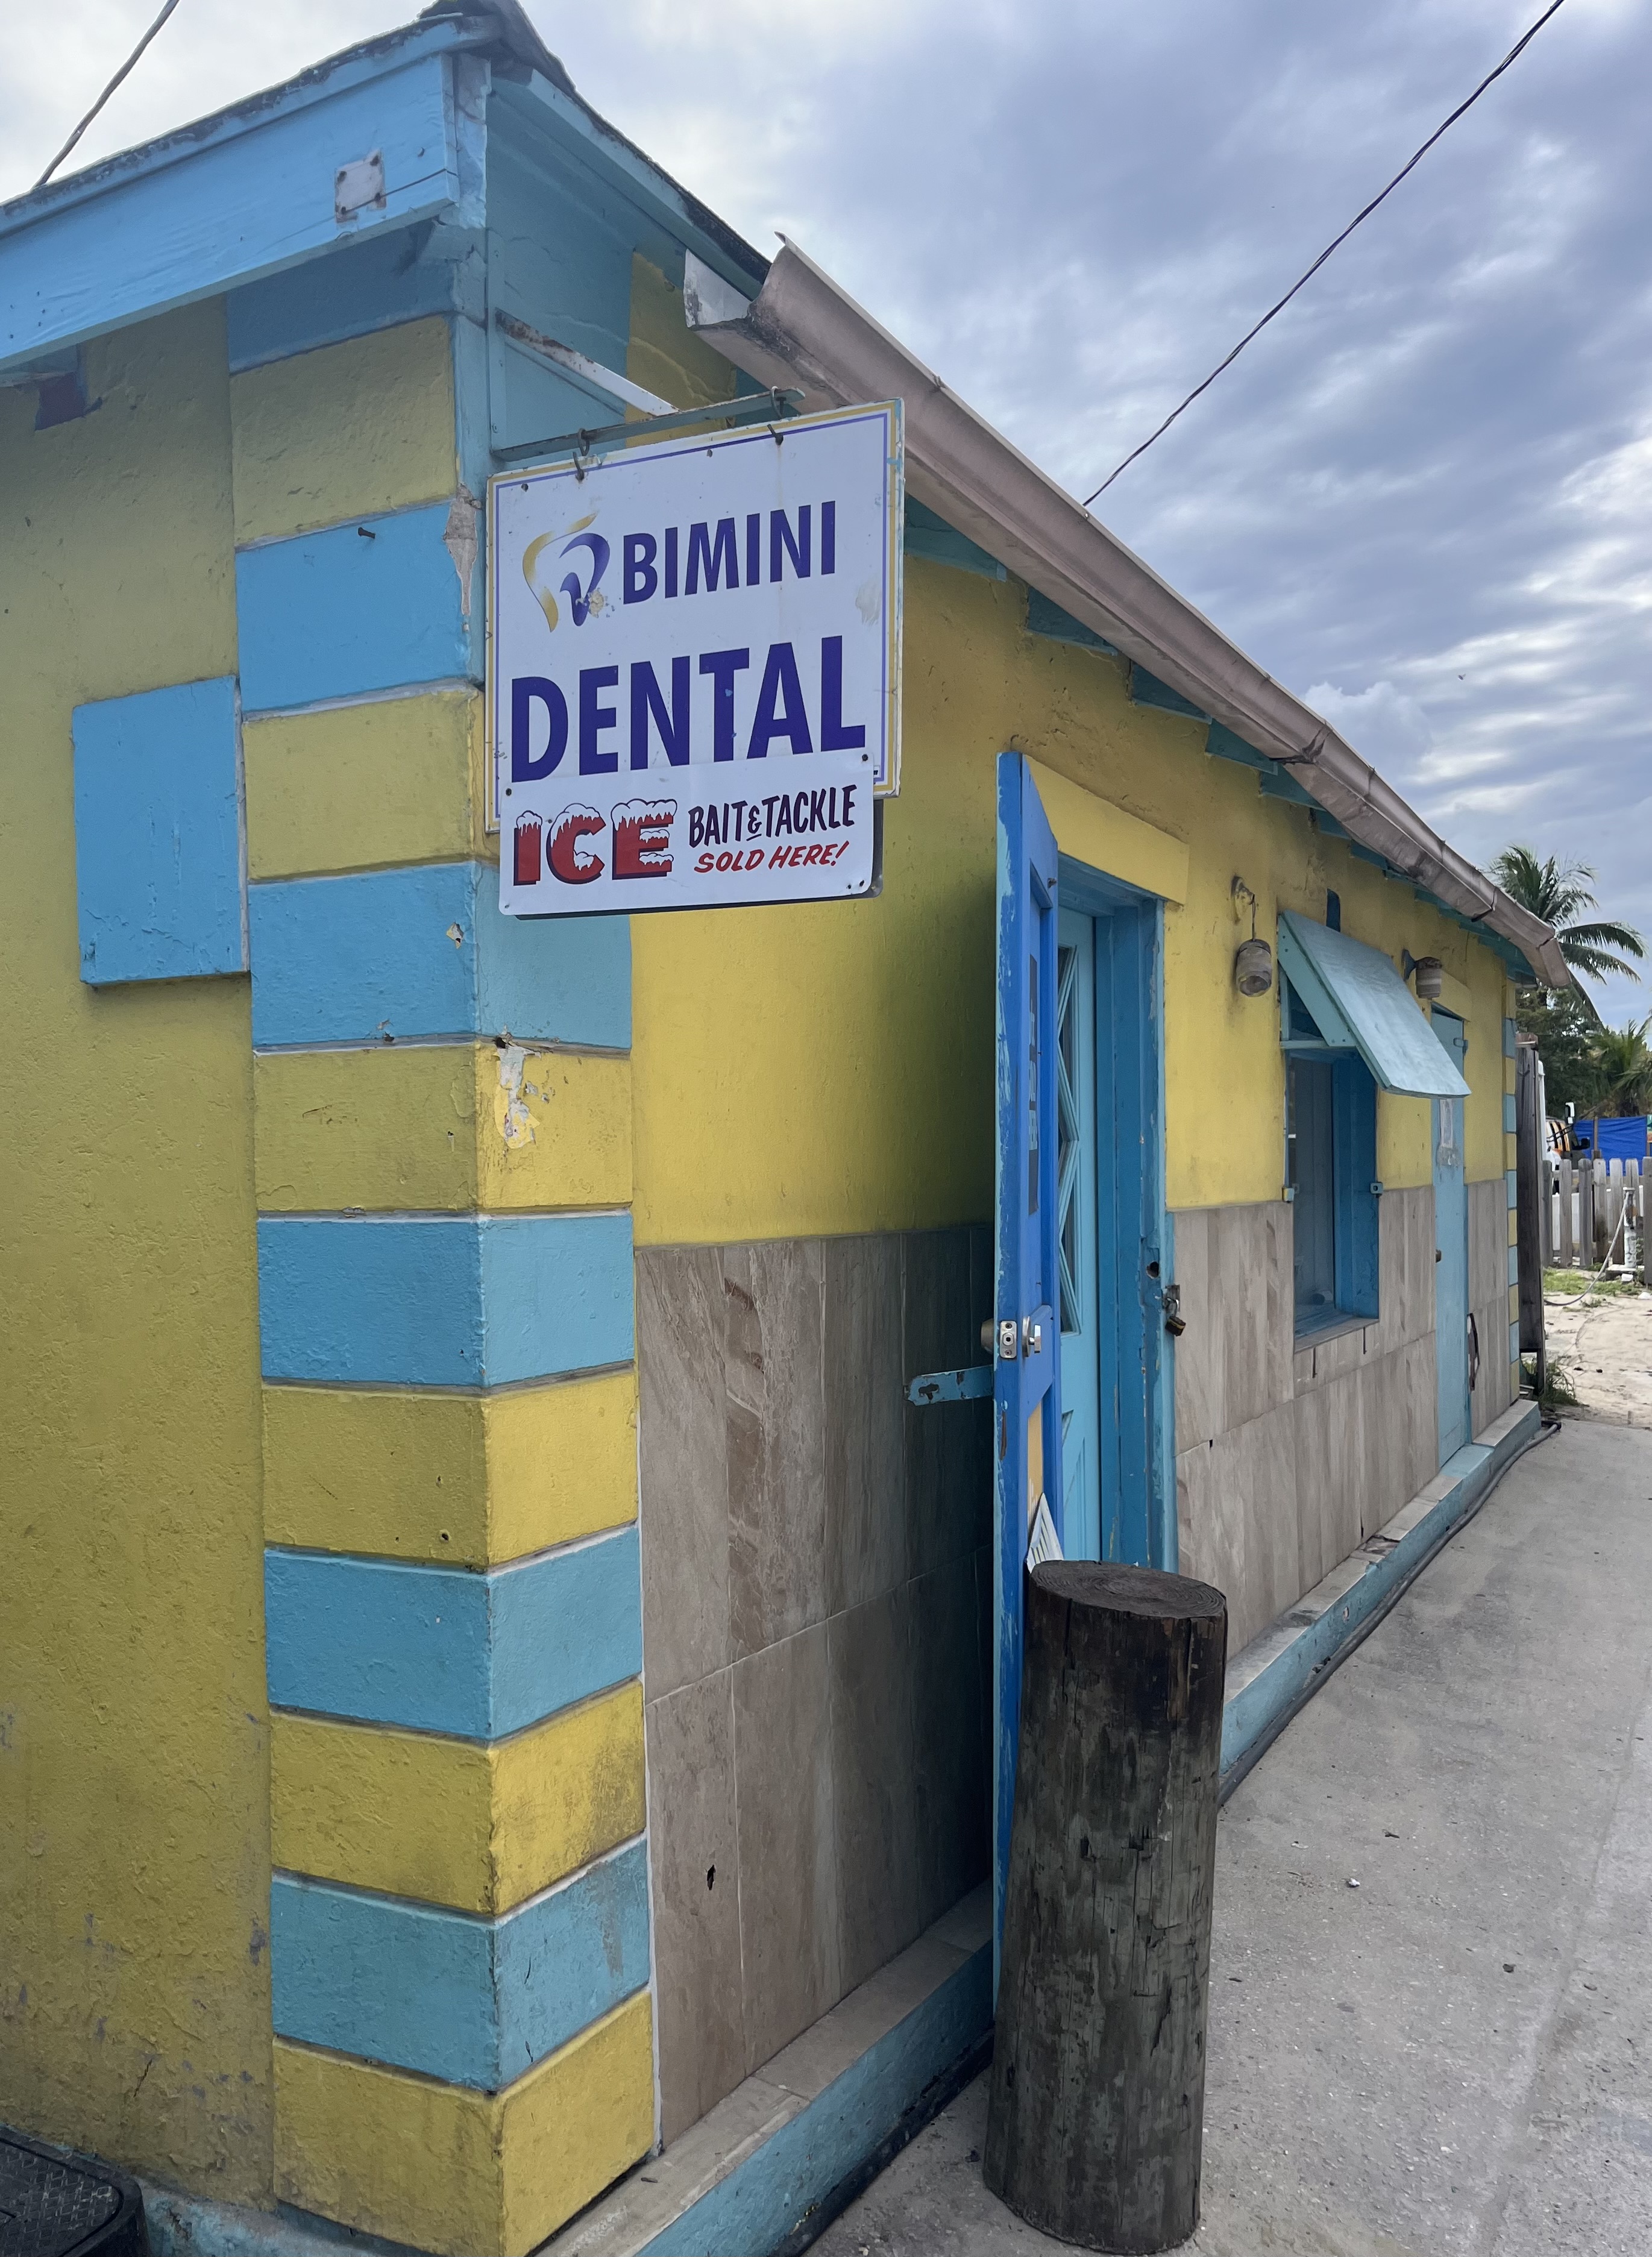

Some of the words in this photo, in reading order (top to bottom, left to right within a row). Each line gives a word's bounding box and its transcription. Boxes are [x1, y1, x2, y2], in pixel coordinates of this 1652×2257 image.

[623, 500, 836, 605] BIMINI
[511, 635, 865, 783] DENTAL
[513, 798, 678, 887] ICE
[694, 848, 765, 873] SOLD
[768, 840, 850, 870] HERE!
